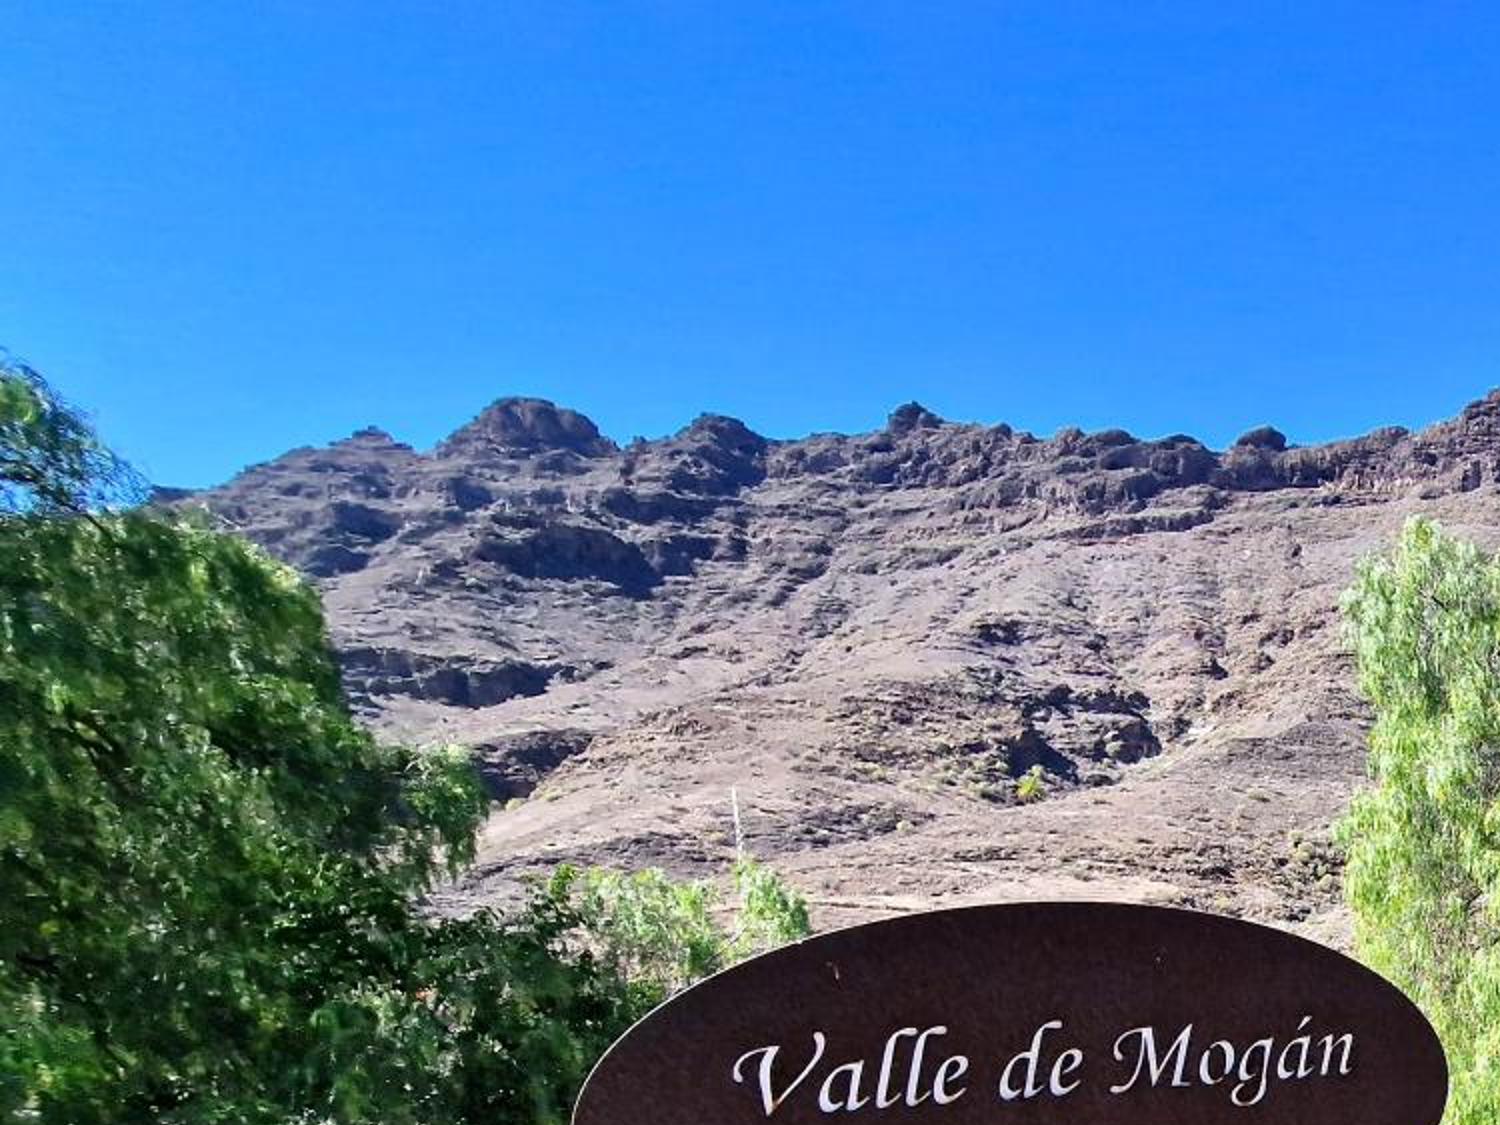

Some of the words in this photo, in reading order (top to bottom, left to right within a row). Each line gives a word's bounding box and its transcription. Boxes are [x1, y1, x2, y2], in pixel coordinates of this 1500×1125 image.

[732, 1025, 969, 1116] Valle
[999, 1020, 1083, 1100] de
[1109, 1015, 1353, 1107] Mogán
